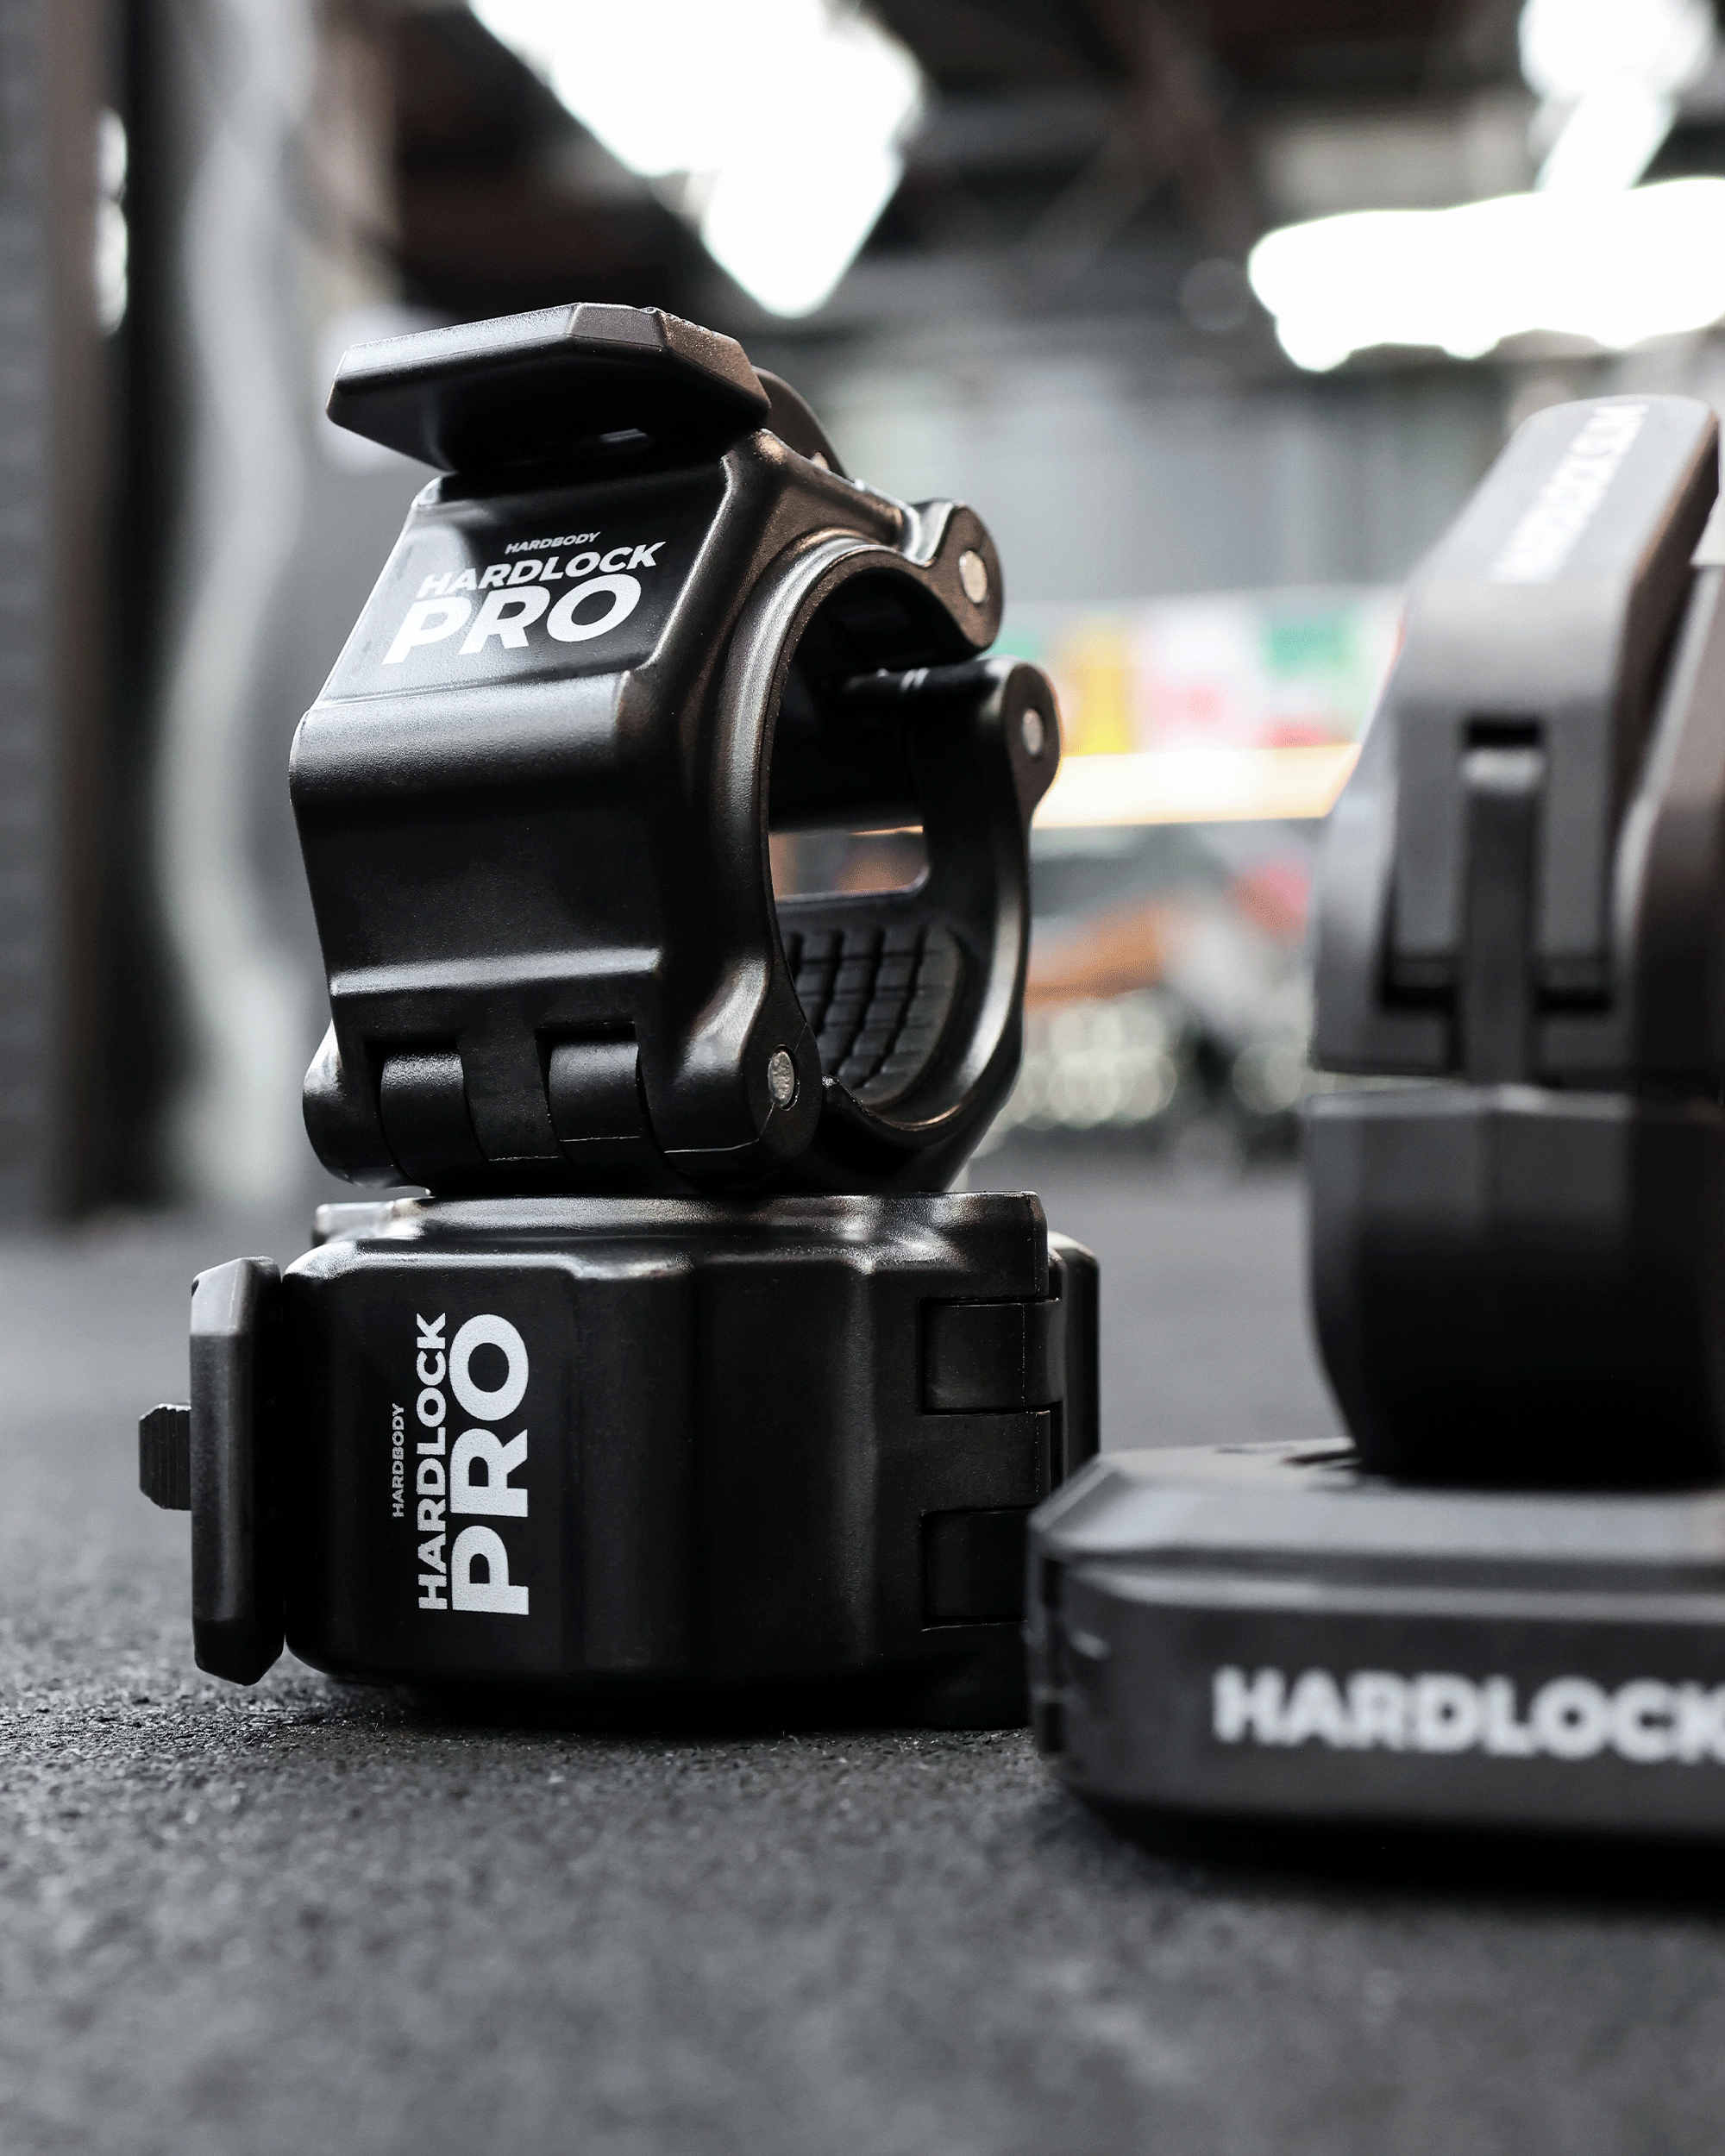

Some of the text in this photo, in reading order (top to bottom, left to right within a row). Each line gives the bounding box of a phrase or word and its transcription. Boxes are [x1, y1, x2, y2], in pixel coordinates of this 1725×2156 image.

[416, 542, 666, 599] HARDLOCK
[505, 531, 601, 555] HARDBODY
[381, 573, 642, 665] PRO
[391, 1403, 405, 1518] HARDBODY
[416, 1312, 448, 1610] HARDLOCK
[448, 1313, 530, 1615] PRO
